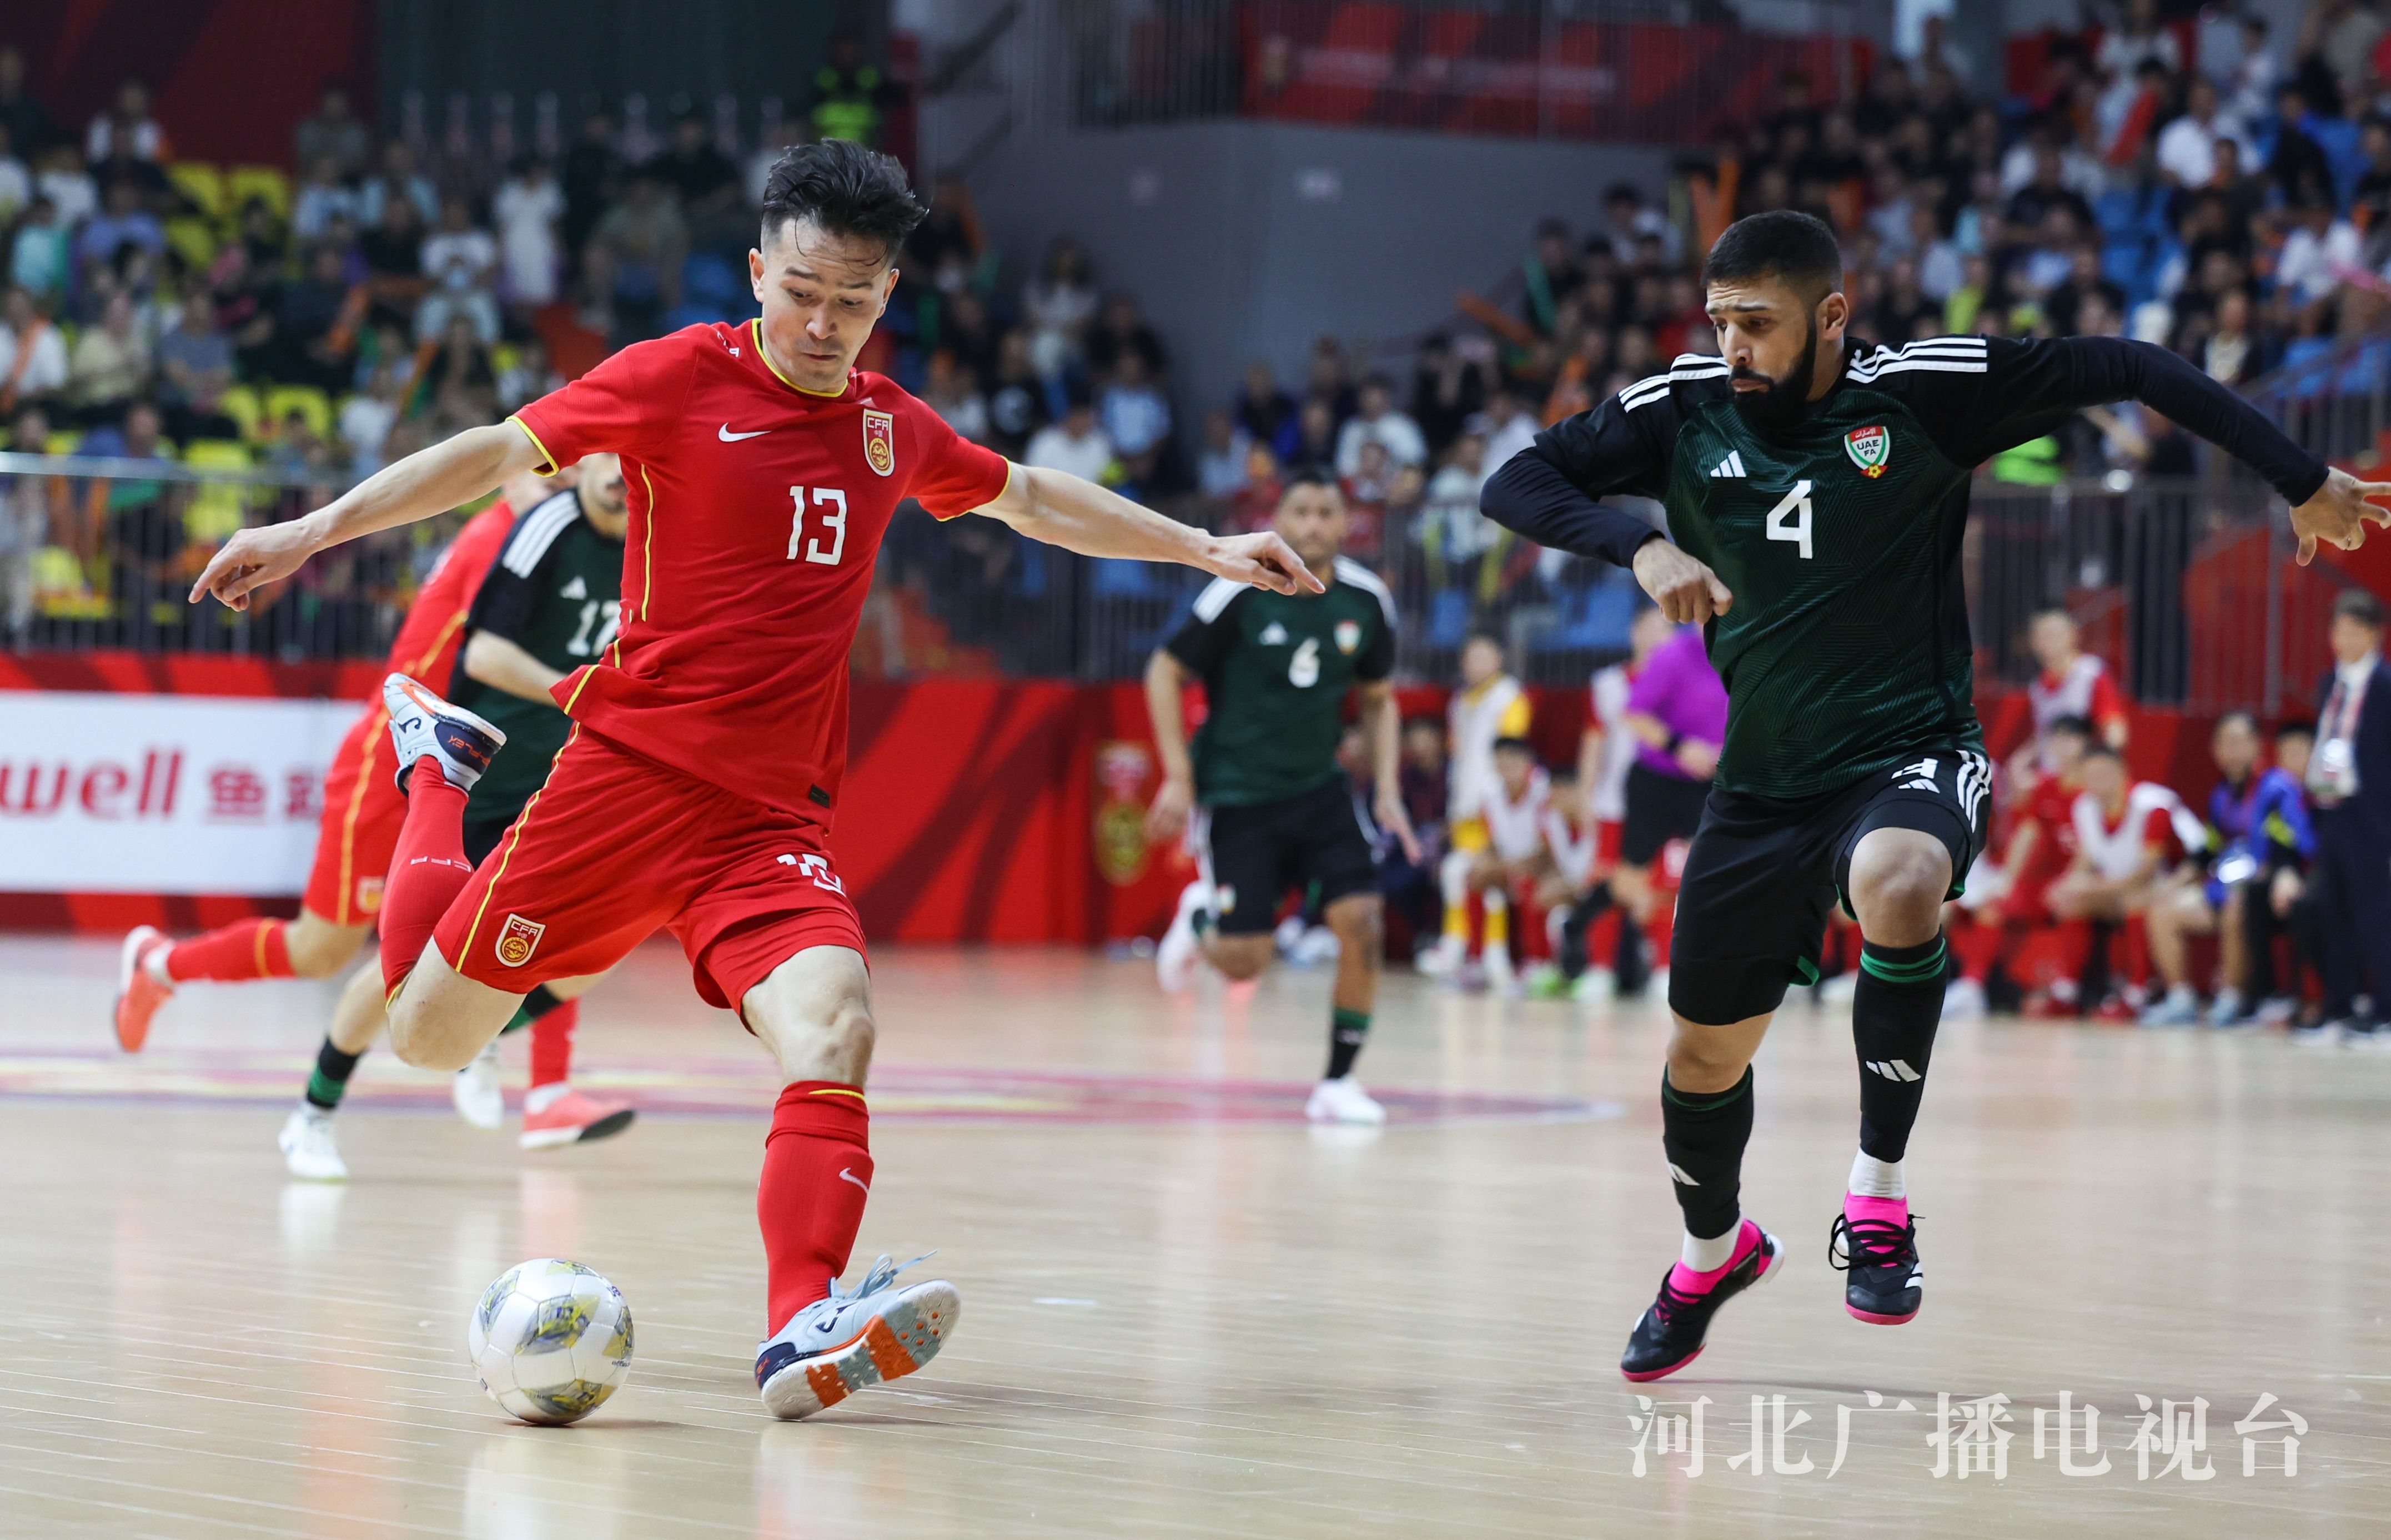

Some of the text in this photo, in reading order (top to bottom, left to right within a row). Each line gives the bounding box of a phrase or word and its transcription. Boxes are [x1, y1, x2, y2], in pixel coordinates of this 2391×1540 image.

[867, 417, 888, 431] CFA
[1856, 439, 1880, 450] UAE
[786, 485, 848, 566] 13
[1766, 479, 1814, 560] 4
[566, 599, 621, 657] 17
[1288, 637, 1321, 689] 6
[510, 920, 538, 937] CFA
